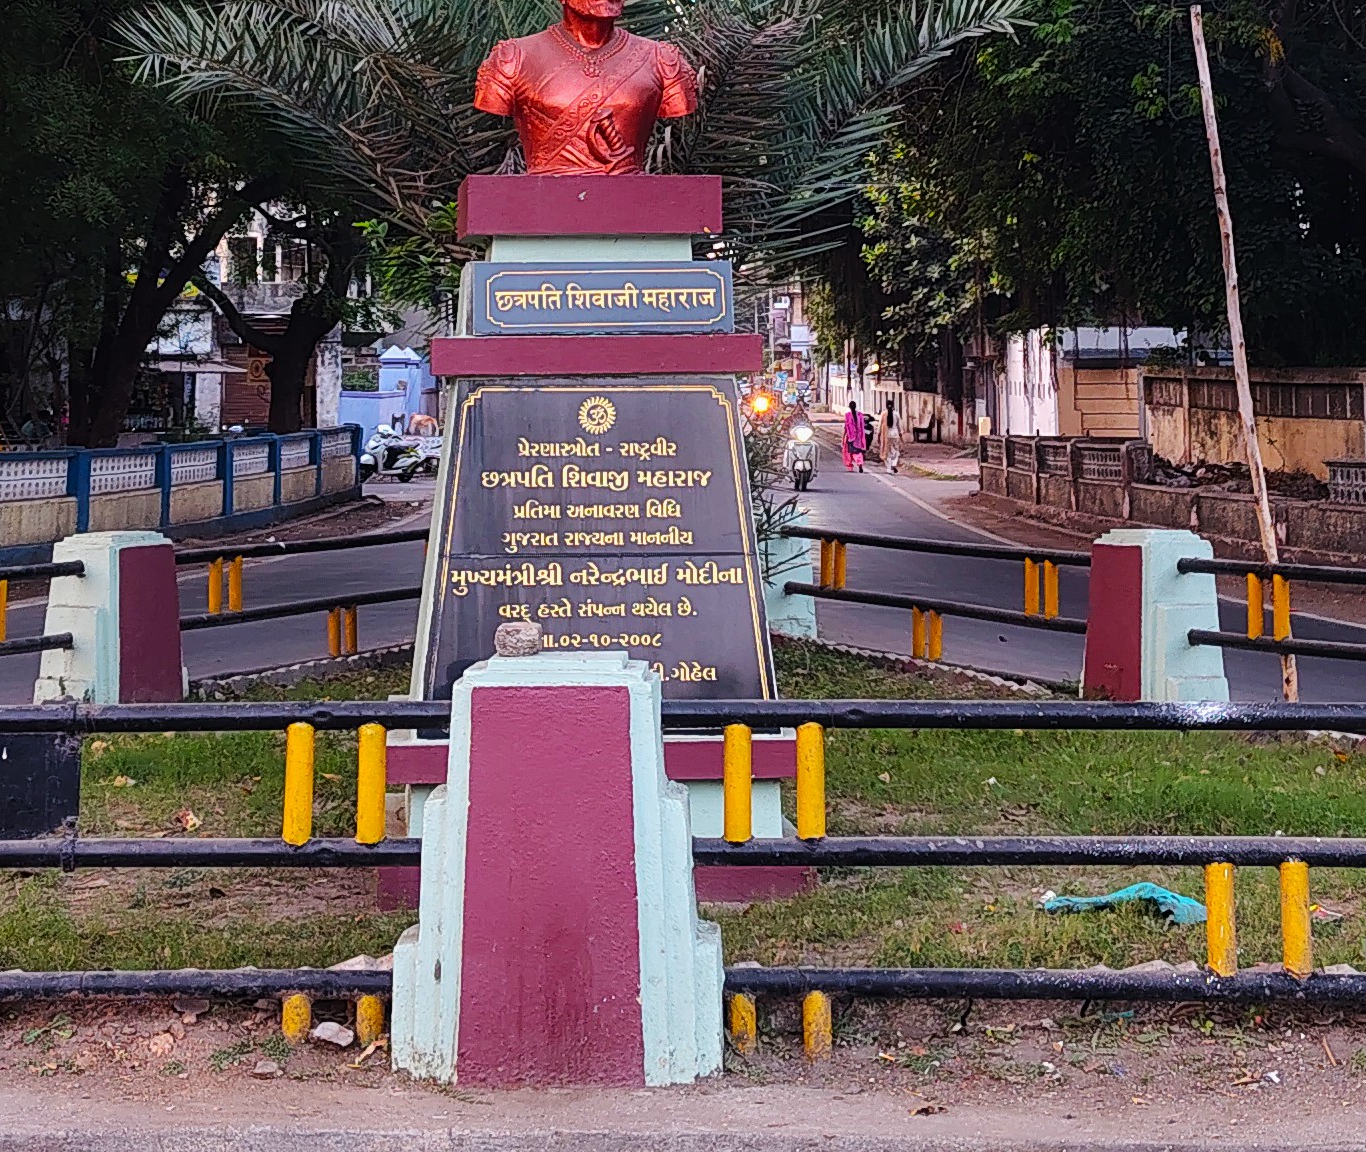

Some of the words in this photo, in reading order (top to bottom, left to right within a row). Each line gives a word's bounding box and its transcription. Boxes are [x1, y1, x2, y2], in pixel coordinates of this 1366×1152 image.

[495, 283, 562, 311] छत्रपति
[565, 282, 638, 309] शिवाजी
[641, 288, 716, 313] महाराज
[619, 436, 677, 461] રાષ્ટ્રવીર
[481, 464, 555, 488] છત્રપતિ
[562, 464, 629, 492] શિવાજી
[637, 470, 712, 488] મહારાજ
[513, 499, 561, 519] પ્રતિમા
[566, 504, 640, 519] અનાવરણ
[645, 498, 682, 518] વિધિ
[501, 532, 559, 554] ગુજરાત
[563, 532, 625, 546] રાજ્યના
[629, 525, 694, 546] માનનીય
[569, 561, 669, 587] નરેન્દ્રભાઈ
[676, 561, 744, 585] મોદીના
[537, 597, 573, 618] હસ્તે
[577, 598, 627, 617] સંપન્ન
[631, 597, 673, 617] થયેલ
[677, 597, 698, 617] છે.
[649, 661, 718, 682] ી.ગોહેલ
